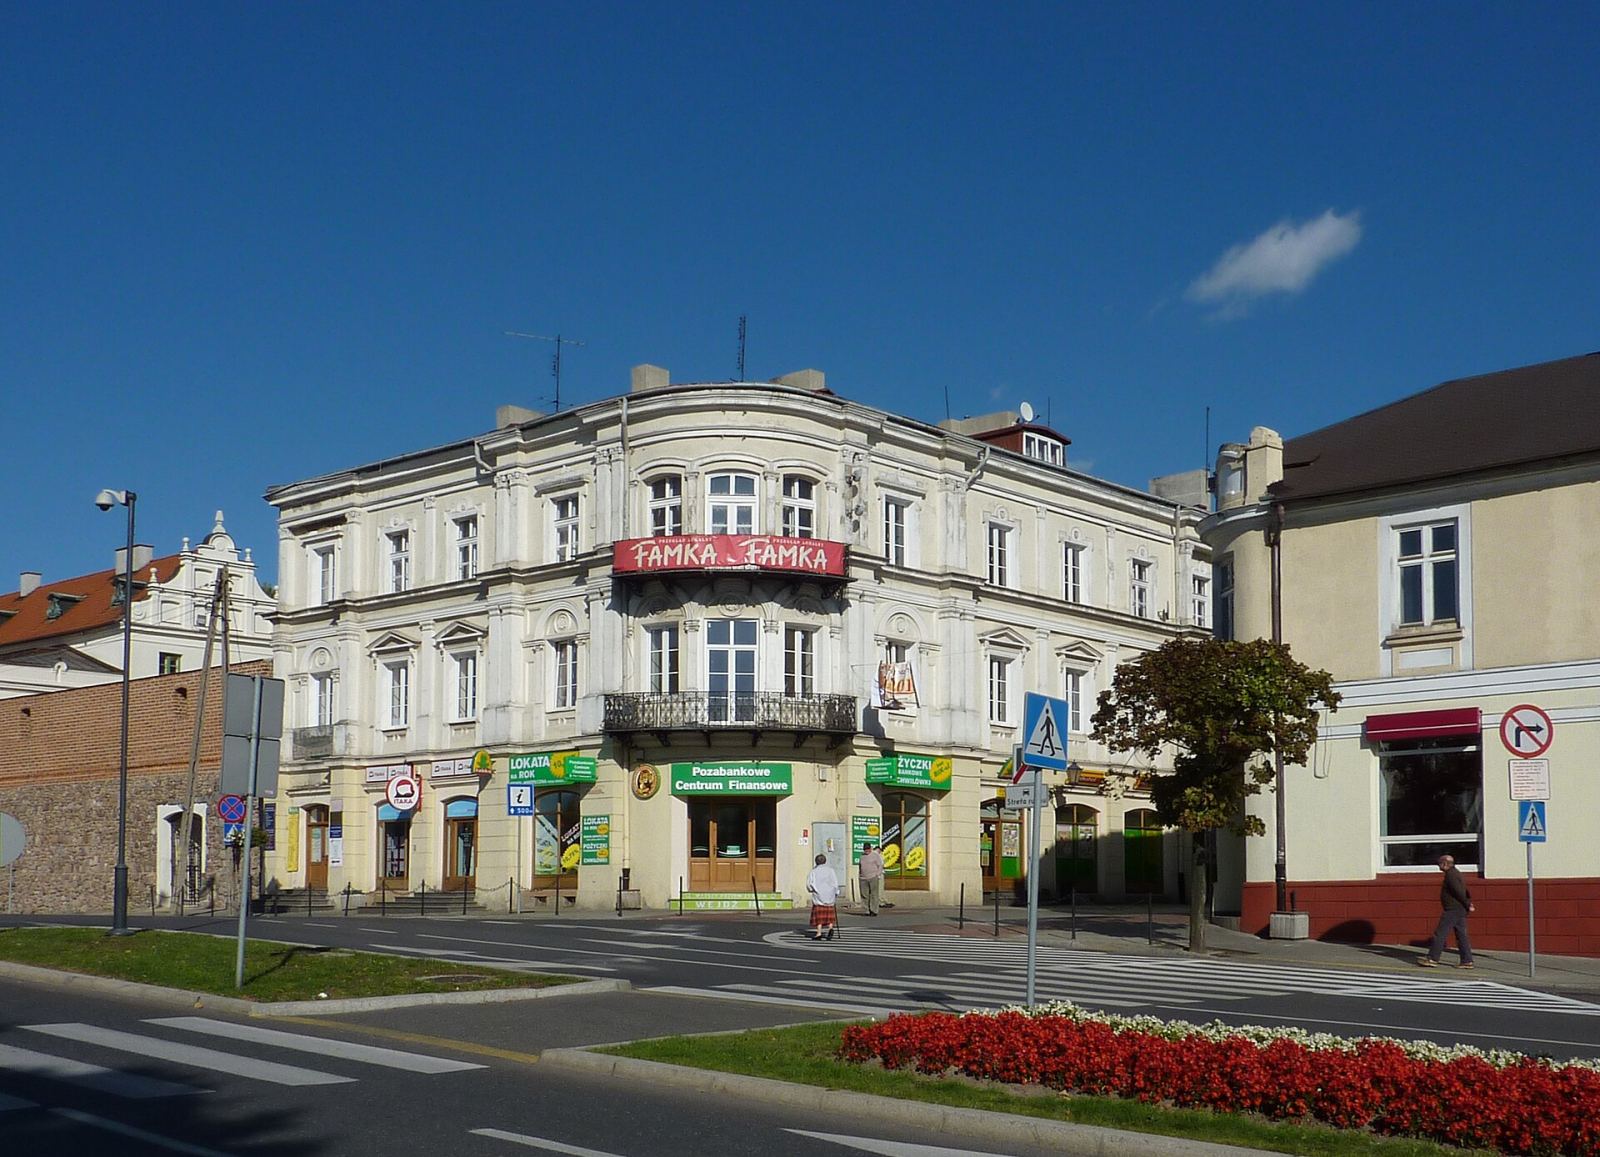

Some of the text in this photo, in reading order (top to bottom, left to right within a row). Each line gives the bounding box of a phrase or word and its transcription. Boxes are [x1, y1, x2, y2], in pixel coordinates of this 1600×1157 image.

[630, 540, 718, 568] FAMKA
[738, 538, 828, 570] FAMKA
[510, 755, 550, 770] LOKATA
[519, 769, 535, 779] ROK
[692, 767, 771, 777] Pozabankowe
[675, 780, 788, 790] Centrum Finansowe
[1007, 798, 1027, 806] Strefa
